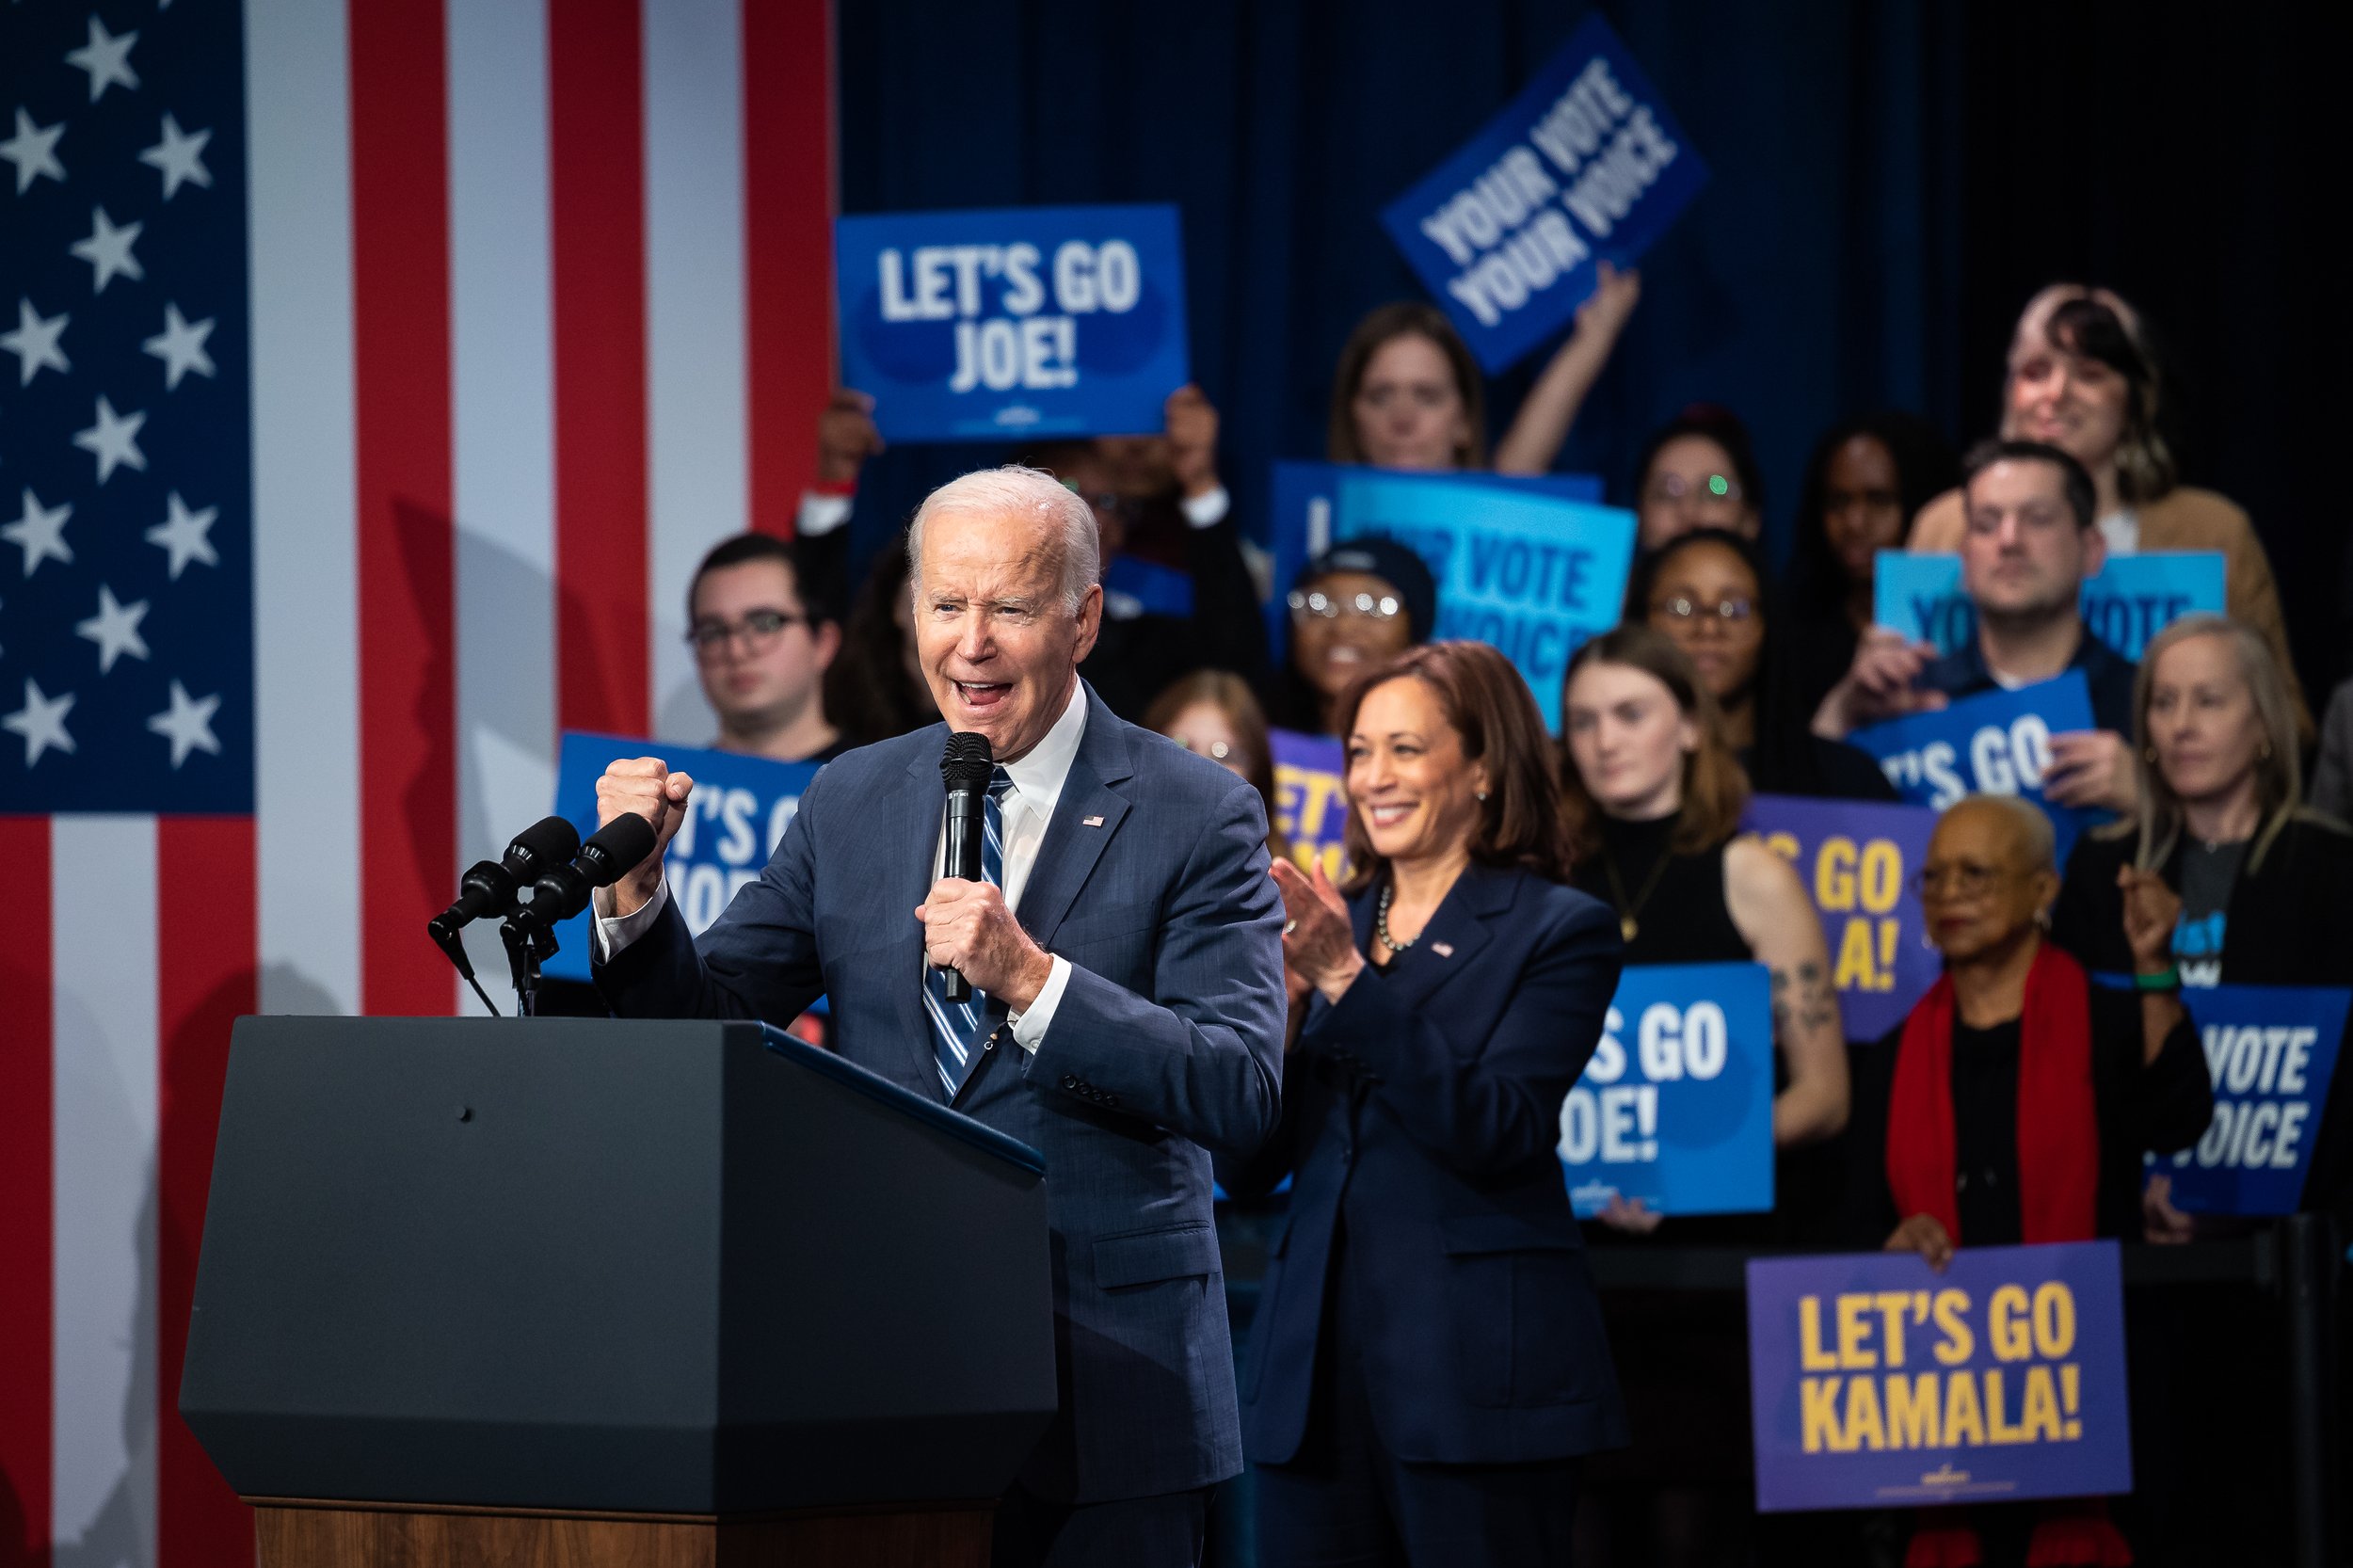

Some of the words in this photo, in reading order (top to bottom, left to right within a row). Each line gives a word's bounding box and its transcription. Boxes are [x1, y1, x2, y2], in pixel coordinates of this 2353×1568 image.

[1421, 145, 1558, 267] YOUR
[1529, 56, 1633, 174] VOTE
[1448, 207, 1591, 328] YOUR
[1562, 104, 1679, 239] VOICE
[878, 242, 1047, 322] LET'S
[1052, 239, 1141, 314] GO
[949, 314, 1079, 393] JOE!
[1470, 532, 1594, 611] VOTE
[1970, 712, 2054, 797] GO
[1815, 833, 1904, 916] GO
[1638, 999, 1729, 1082] GO
[2201, 1023, 2318, 1096] VOTE
[1559, 1085, 1659, 1164] OE!
[2172, 1099, 2311, 1169] OICE
[1799, 1288, 1976, 1372] LET'S
[1988, 1279, 2077, 1363] GO
[1799, 1363, 2083, 1455] KAMALA!
